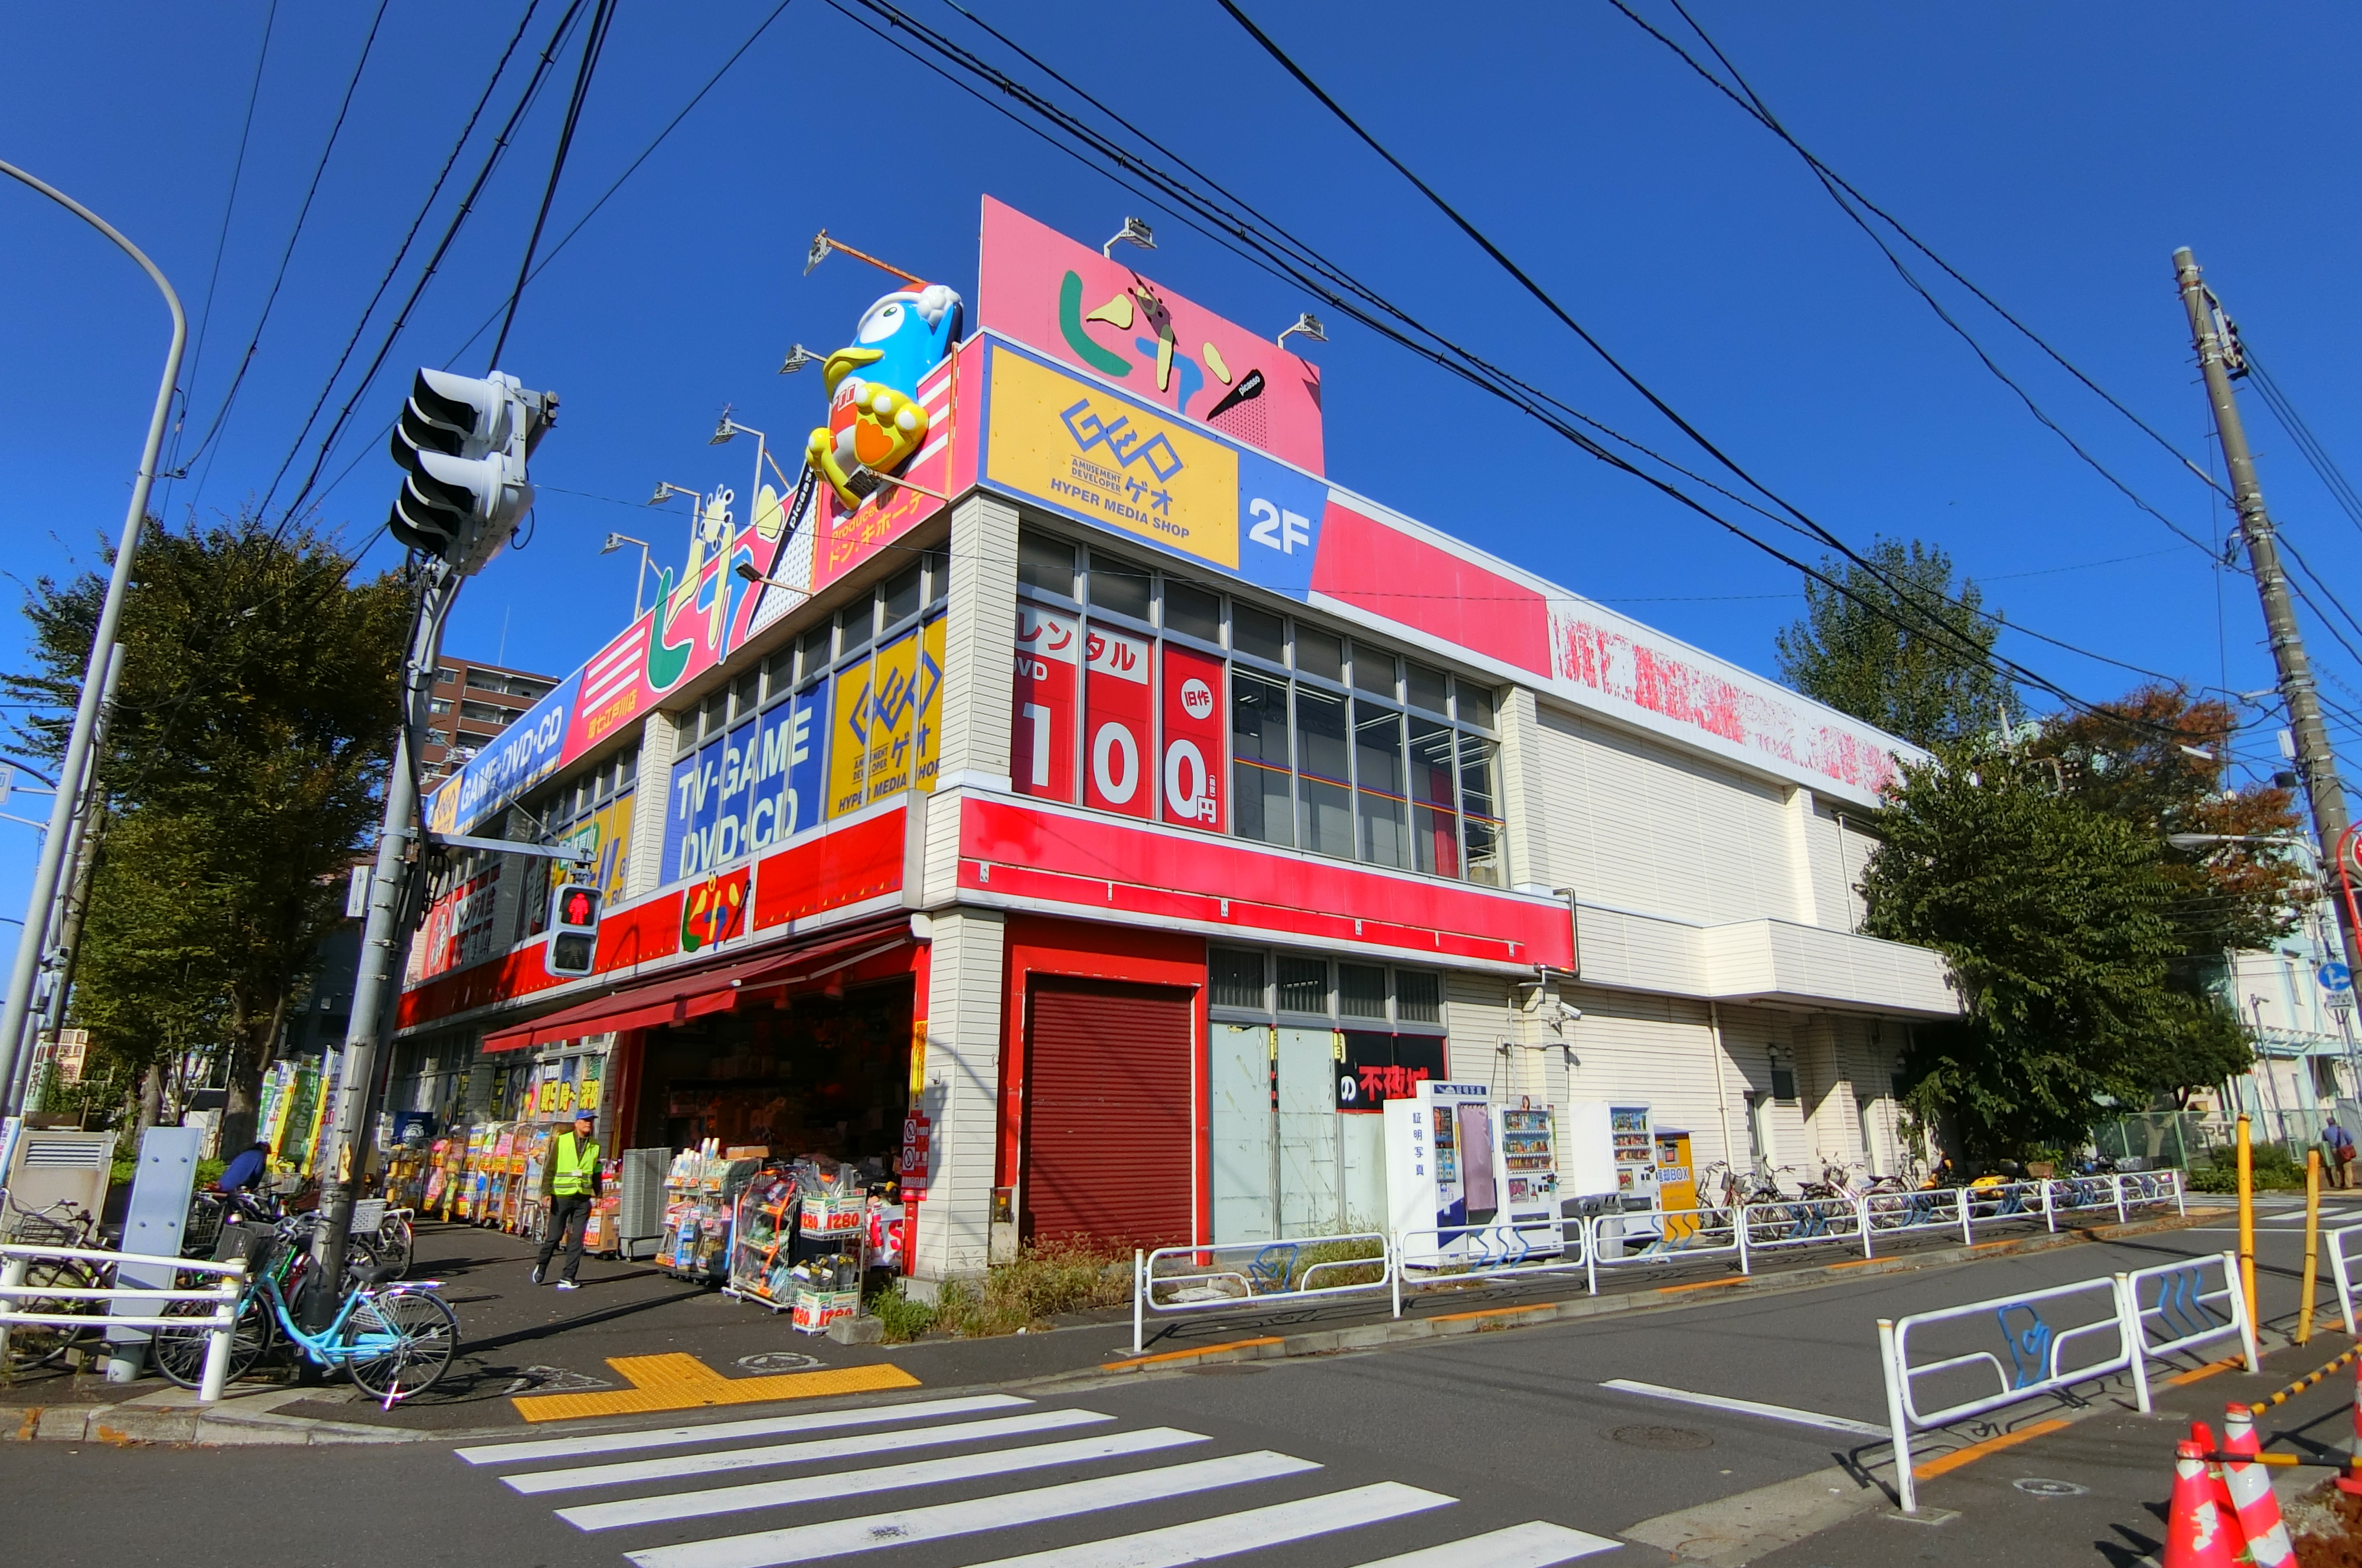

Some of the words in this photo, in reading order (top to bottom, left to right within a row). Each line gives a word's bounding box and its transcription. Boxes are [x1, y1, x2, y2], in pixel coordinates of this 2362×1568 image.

[1238, 375, 1260, 397] picasso
[1072, 459, 1121, 483] AMUSEMENT
[1072, 467, 1121, 493] DEVELOPER
[1050, 478, 1100, 506] HYPER
[1104, 498, 1149, 524] MEDIA
[1153, 517, 1190, 538] SHOP
[1125, 476, 1173, 516] ゲオ
[1248, 497, 1310, 554] 2F
[1017, 612, 1136, 672] レンタル
[1185, 689, 1211, 707] 旧作
[853, 759, 888, 780] DEVOPER
[854, 747, 888, 770] AMEMENT
[873, 772, 907, 798] MEDIA
[1412, 1112, 1424, 1176] 証明写真
[827, 1212, 860, 1230] 1280
